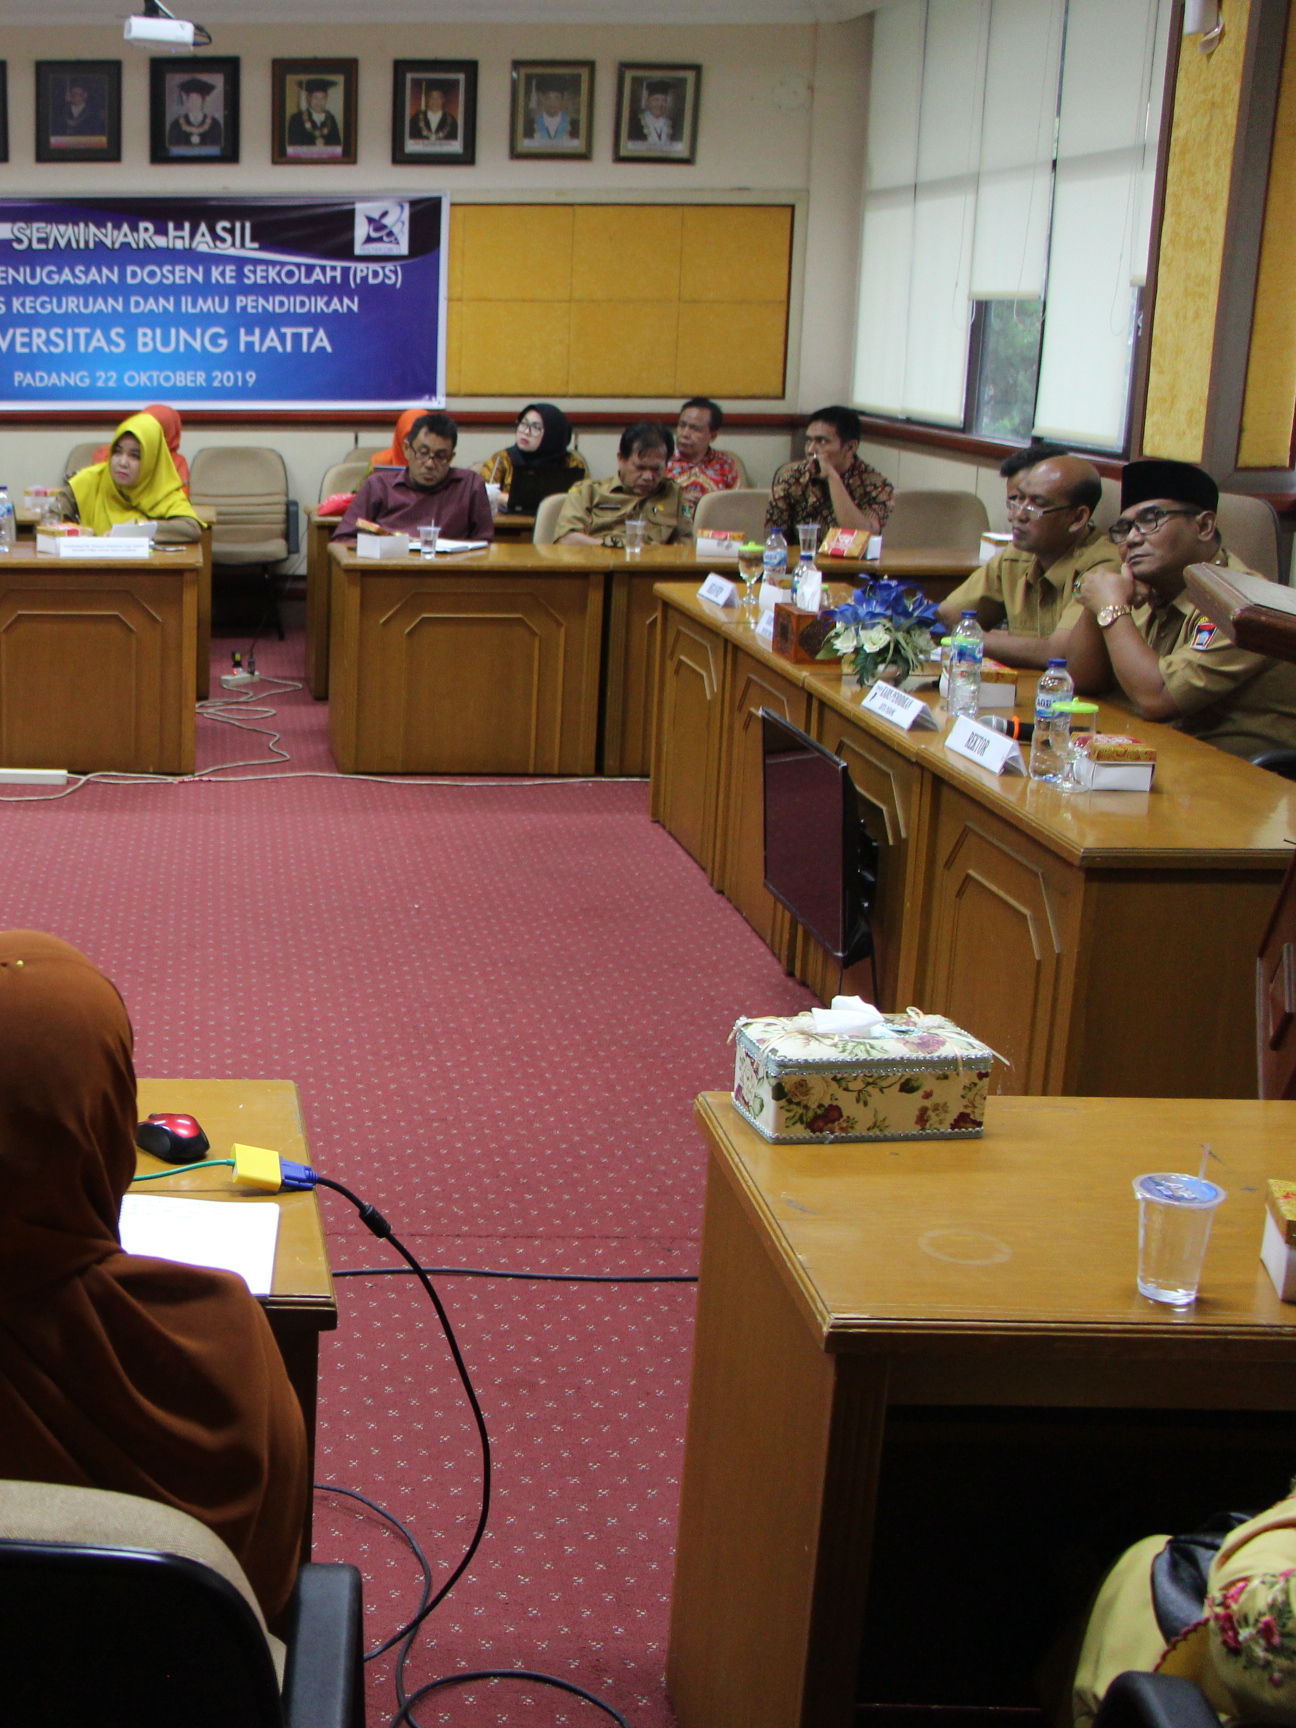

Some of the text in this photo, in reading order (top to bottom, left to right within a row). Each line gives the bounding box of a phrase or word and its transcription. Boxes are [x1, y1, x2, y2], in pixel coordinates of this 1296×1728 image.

[11, 220, 260, 250] SEMINAR HASIL
[125, 264, 204, 285] DOSEN
[210, 264, 237, 285] KE
[243, 264, 342, 285] SEKOLAH
[348, 264, 403, 290] (PDS)
[11, 296, 124, 314] KEGURUAN
[129, 296, 174, 314] DAN
[180, 296, 229, 314] ILMU
[235, 295, 359, 313] PENDIDIKAN
[136, 326, 229, 354] BUNG
[238, 326, 333, 353] HATTA
[13, 370, 257, 388] PADANG 22 OKTOBER 2019
[964, 731, 991, 757] REKTOR
